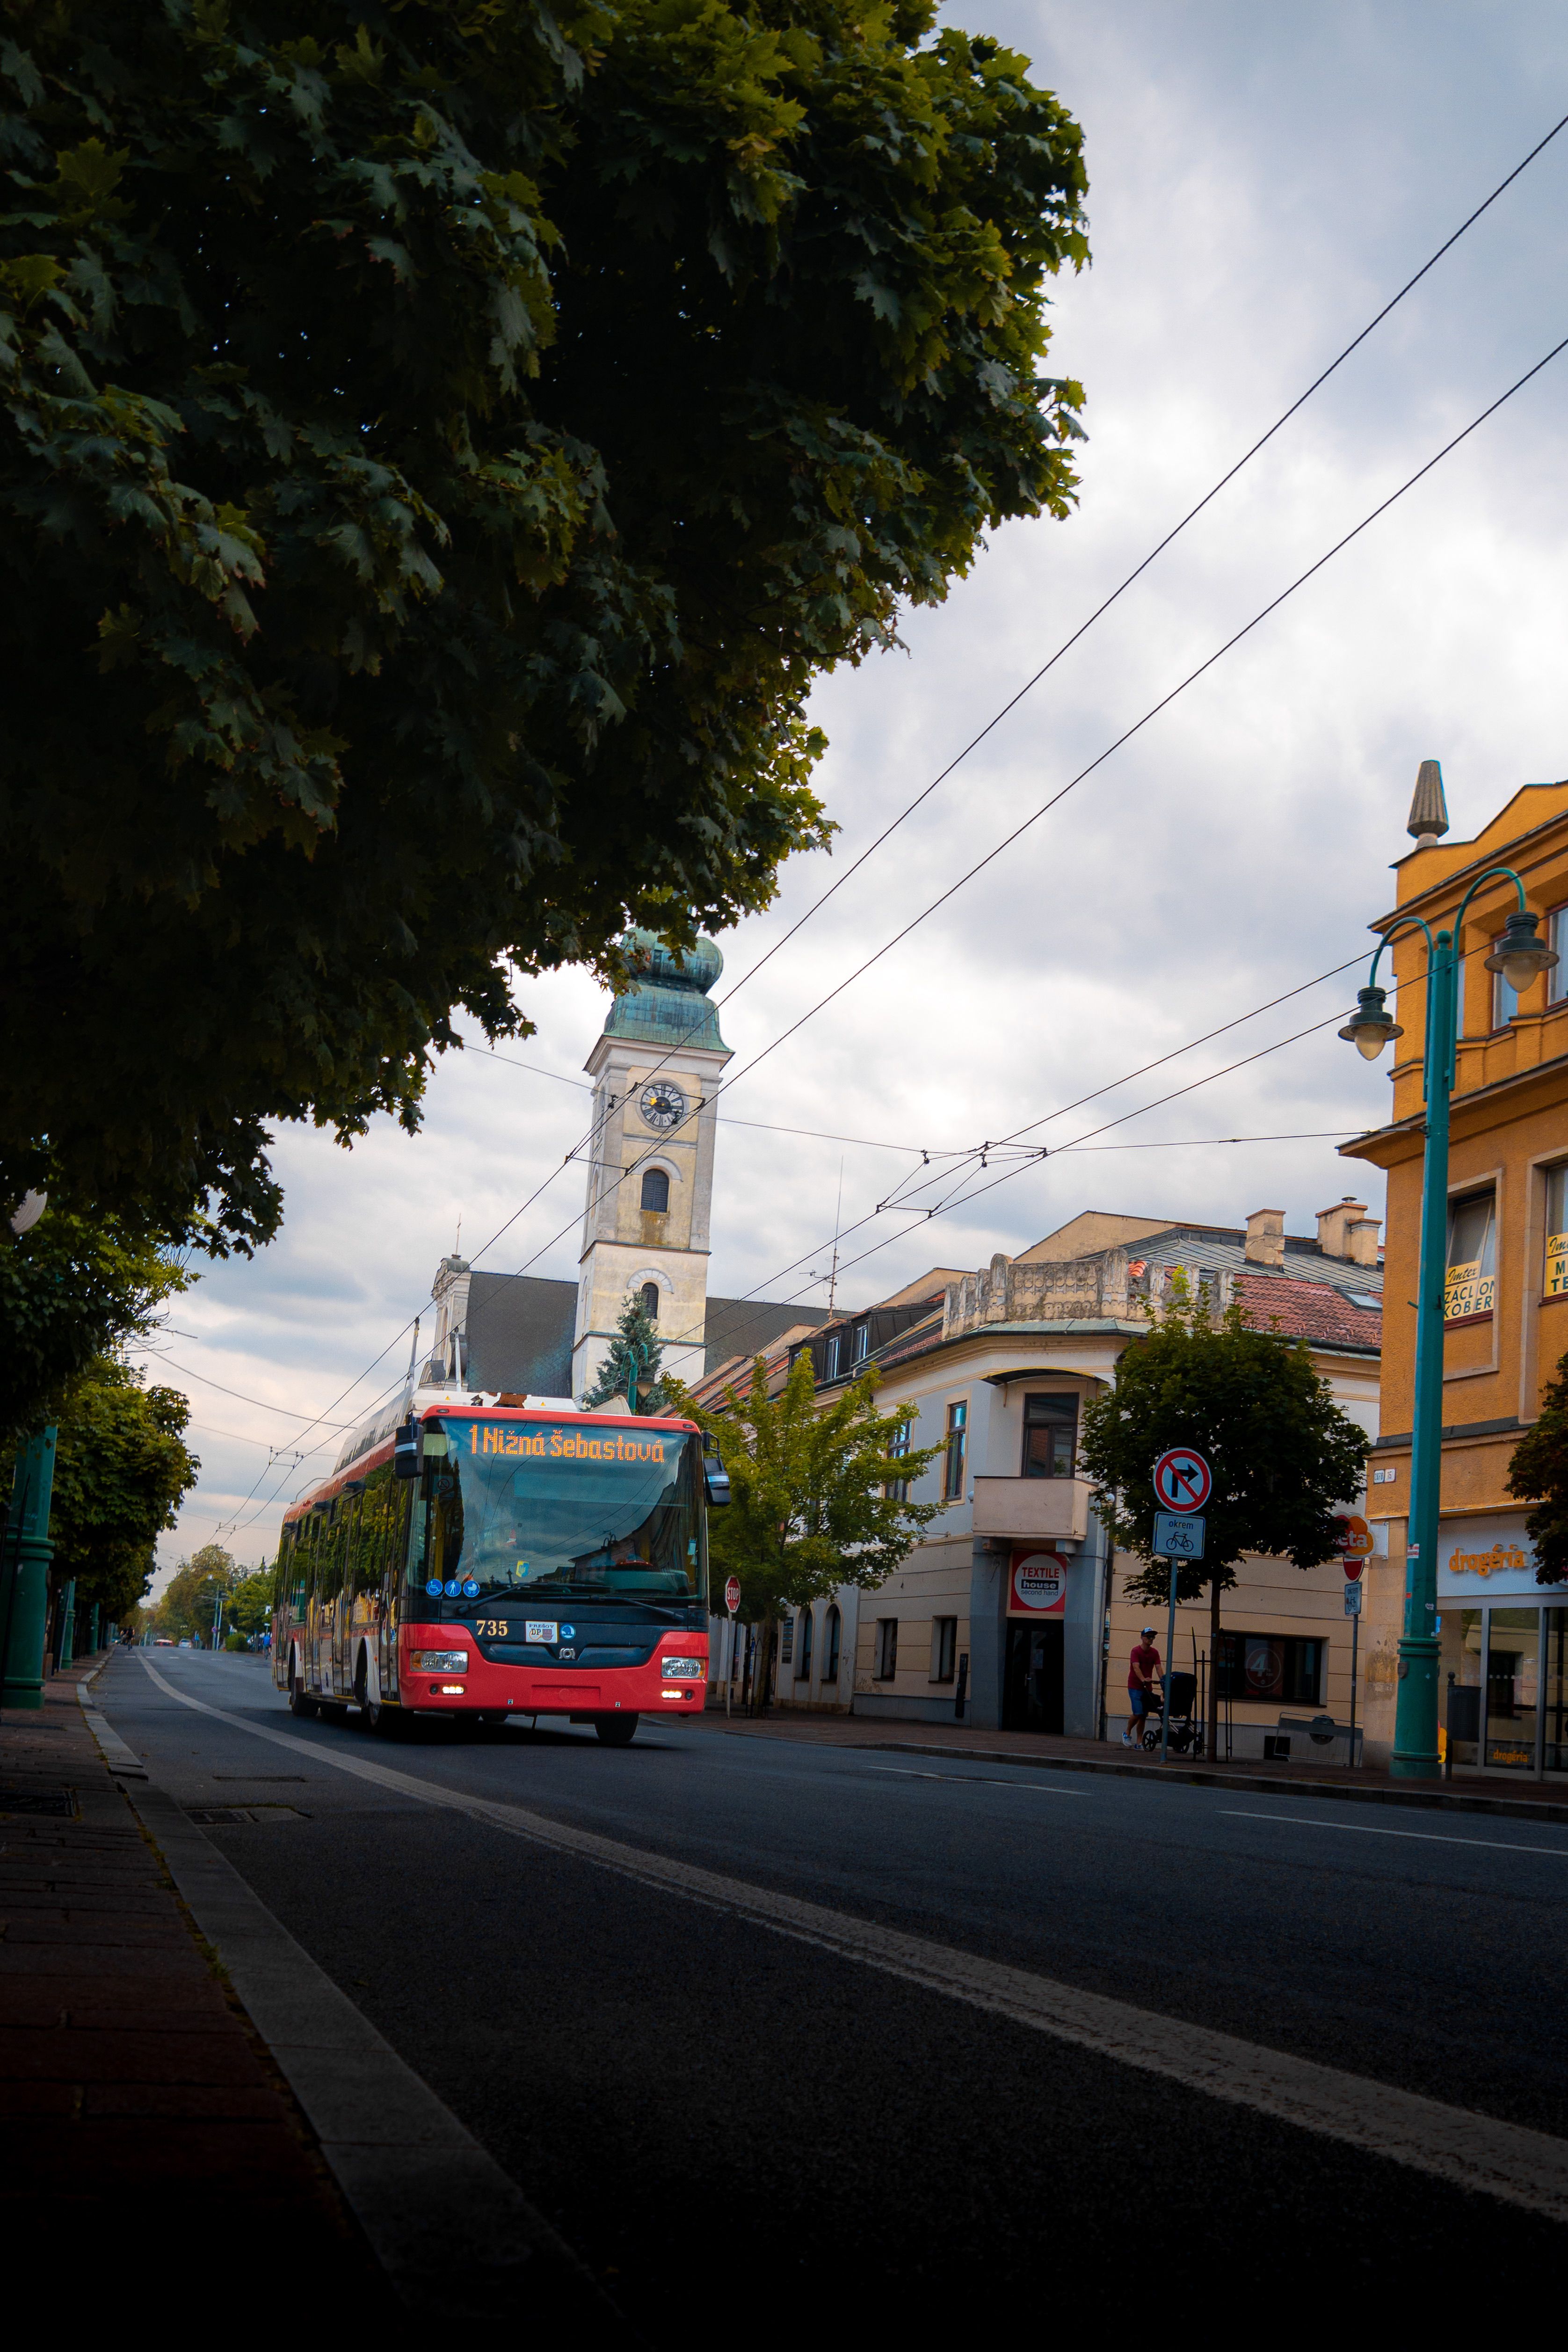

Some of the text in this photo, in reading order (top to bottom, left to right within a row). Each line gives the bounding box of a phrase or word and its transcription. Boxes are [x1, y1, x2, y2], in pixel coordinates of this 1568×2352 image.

[469, 1424, 664, 1463] 1 Nižná Šebastová
[1169, 1519, 1194, 1530] okrem
[1335, 1531, 1368, 1547] eta
[1449, 1544, 1525, 1576] drogéria
[1022, 1567, 1060, 1578] TEXTILE
[1023, 1580, 1057, 1589] house
[727, 1587, 739, 1600] STOP
[476, 1620, 508, 1636] 735
[1249, 1654, 1267, 1677] 4
[1493, 1748, 1528, 1764] drogéria
